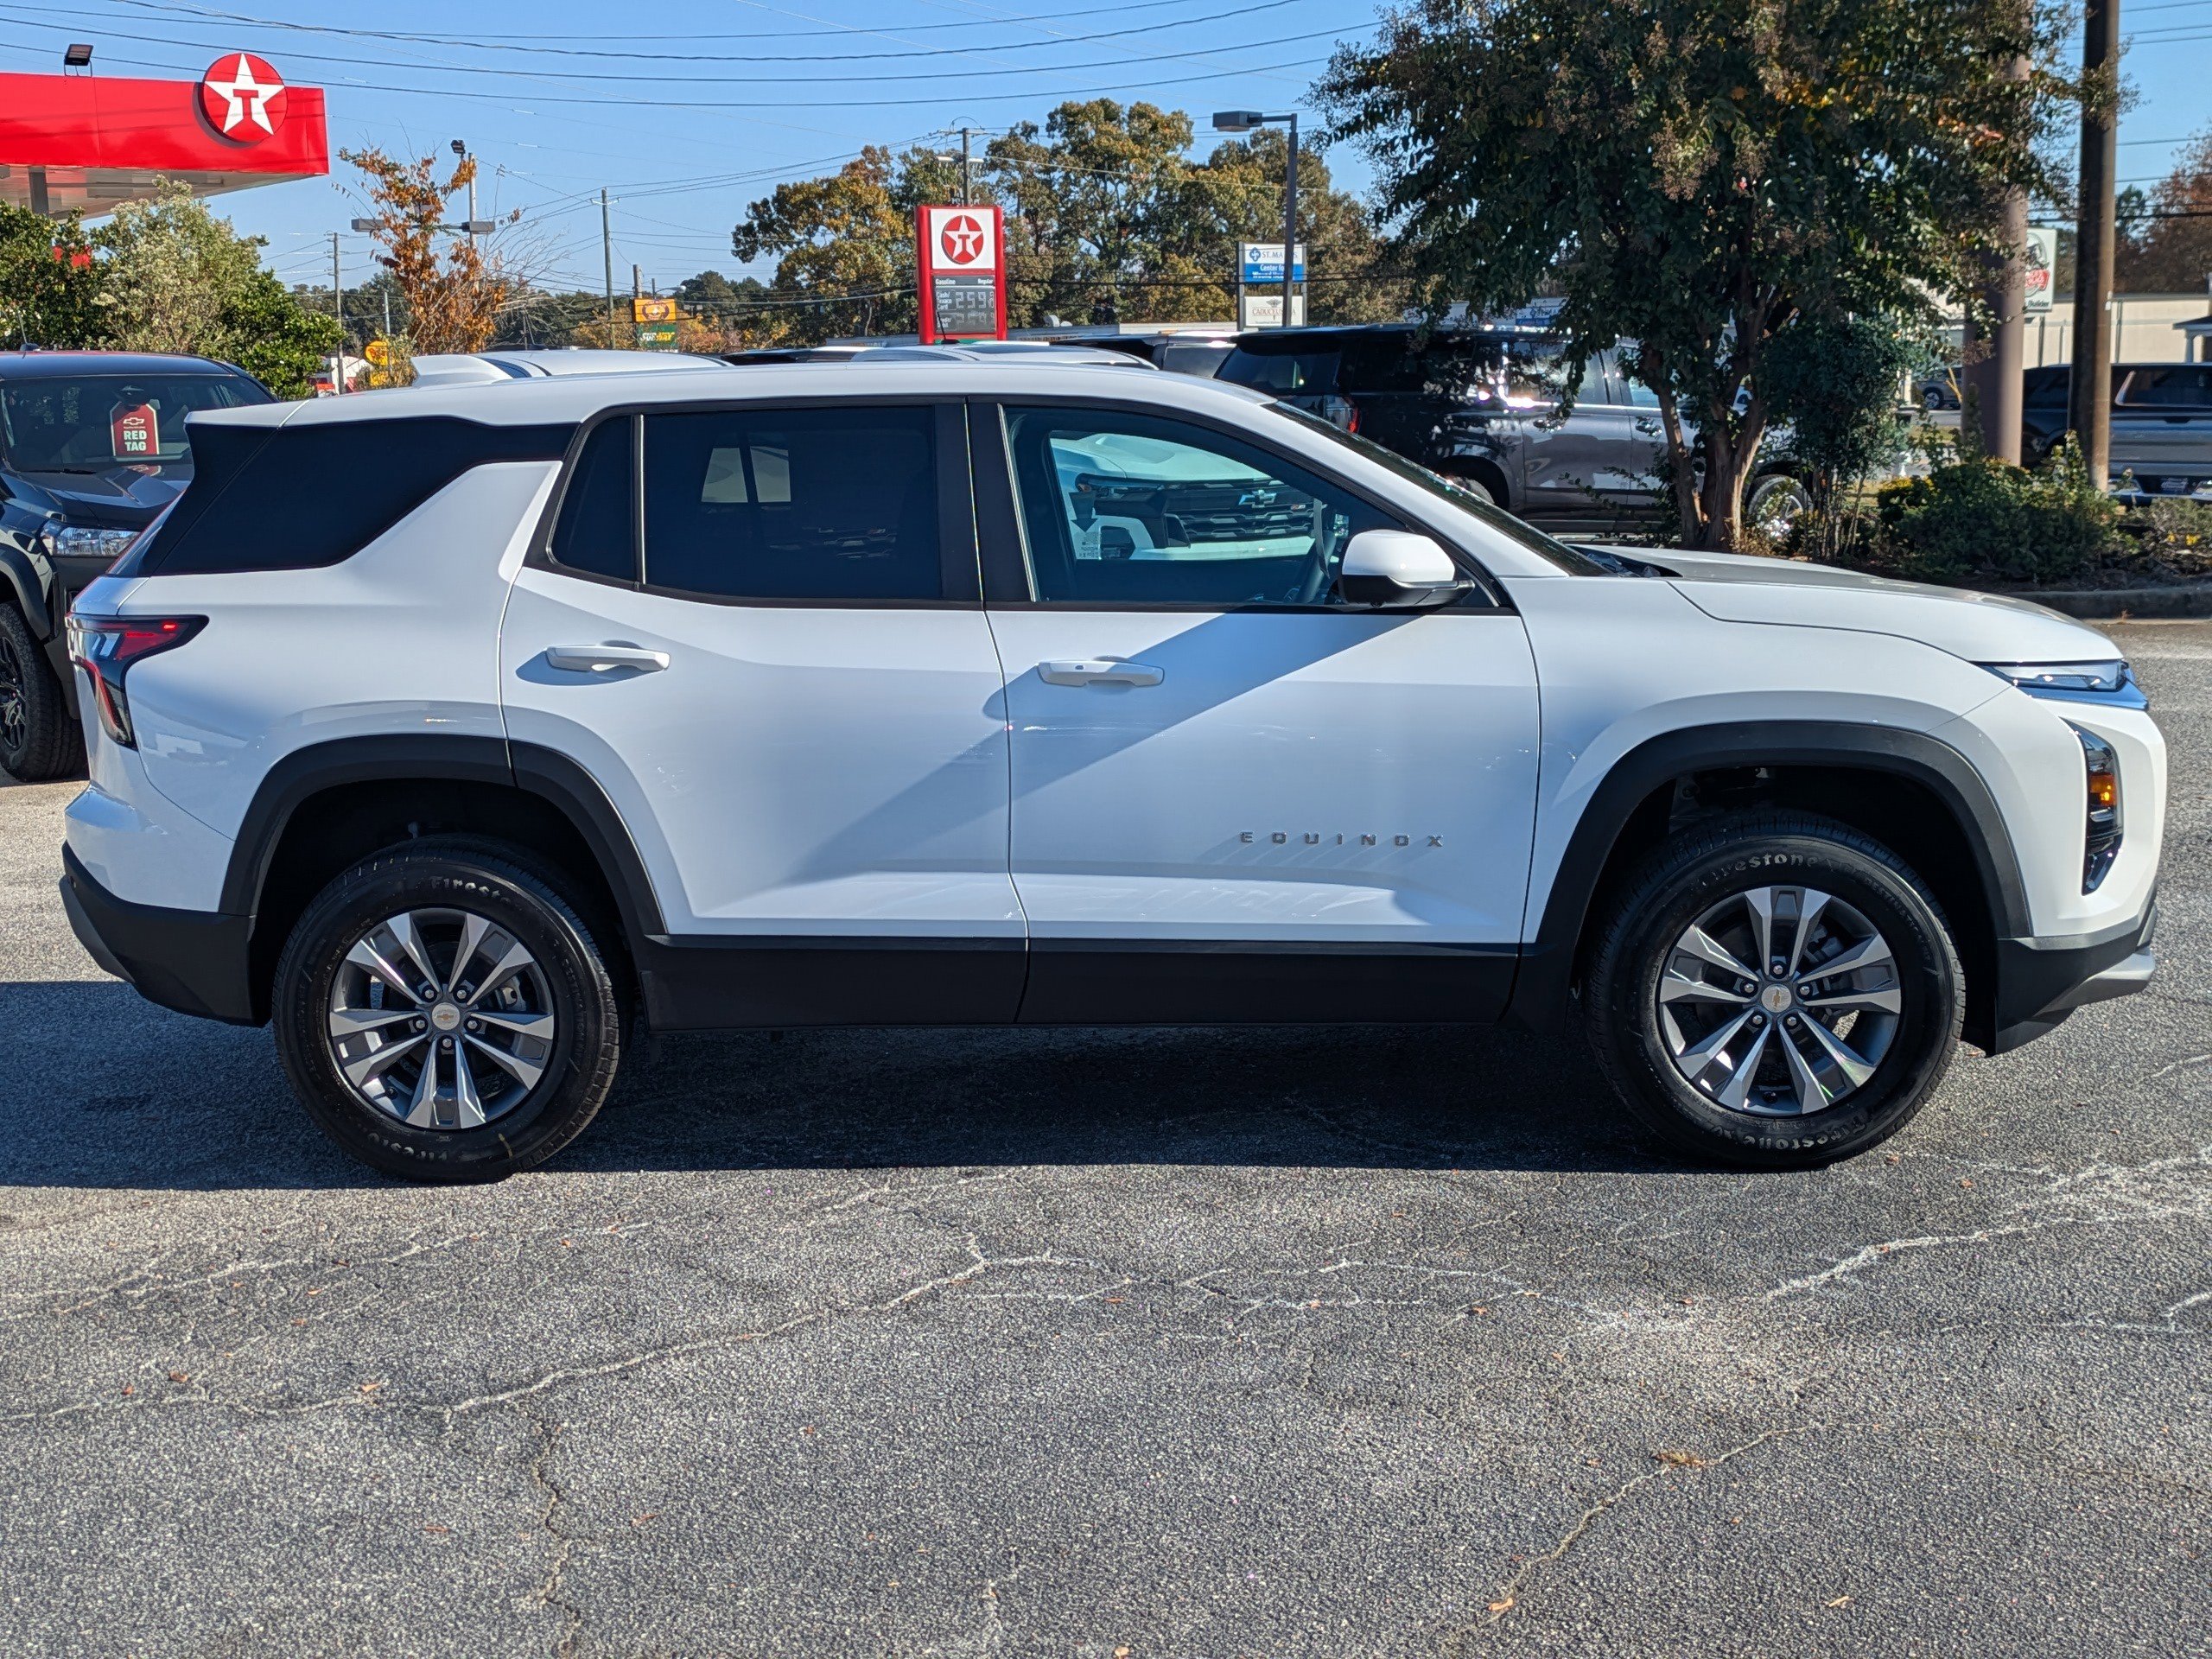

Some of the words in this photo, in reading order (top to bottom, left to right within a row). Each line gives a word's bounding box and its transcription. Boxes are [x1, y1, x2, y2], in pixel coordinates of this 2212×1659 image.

[640, 331, 676, 342] SUBWAY
[123, 430, 148, 441] RED
[124, 442, 147, 452] TAG
[1240, 831, 1444, 848] EQUINOX
[1701, 852, 1821, 887] irestone
[429, 875, 517, 906] Firesto
